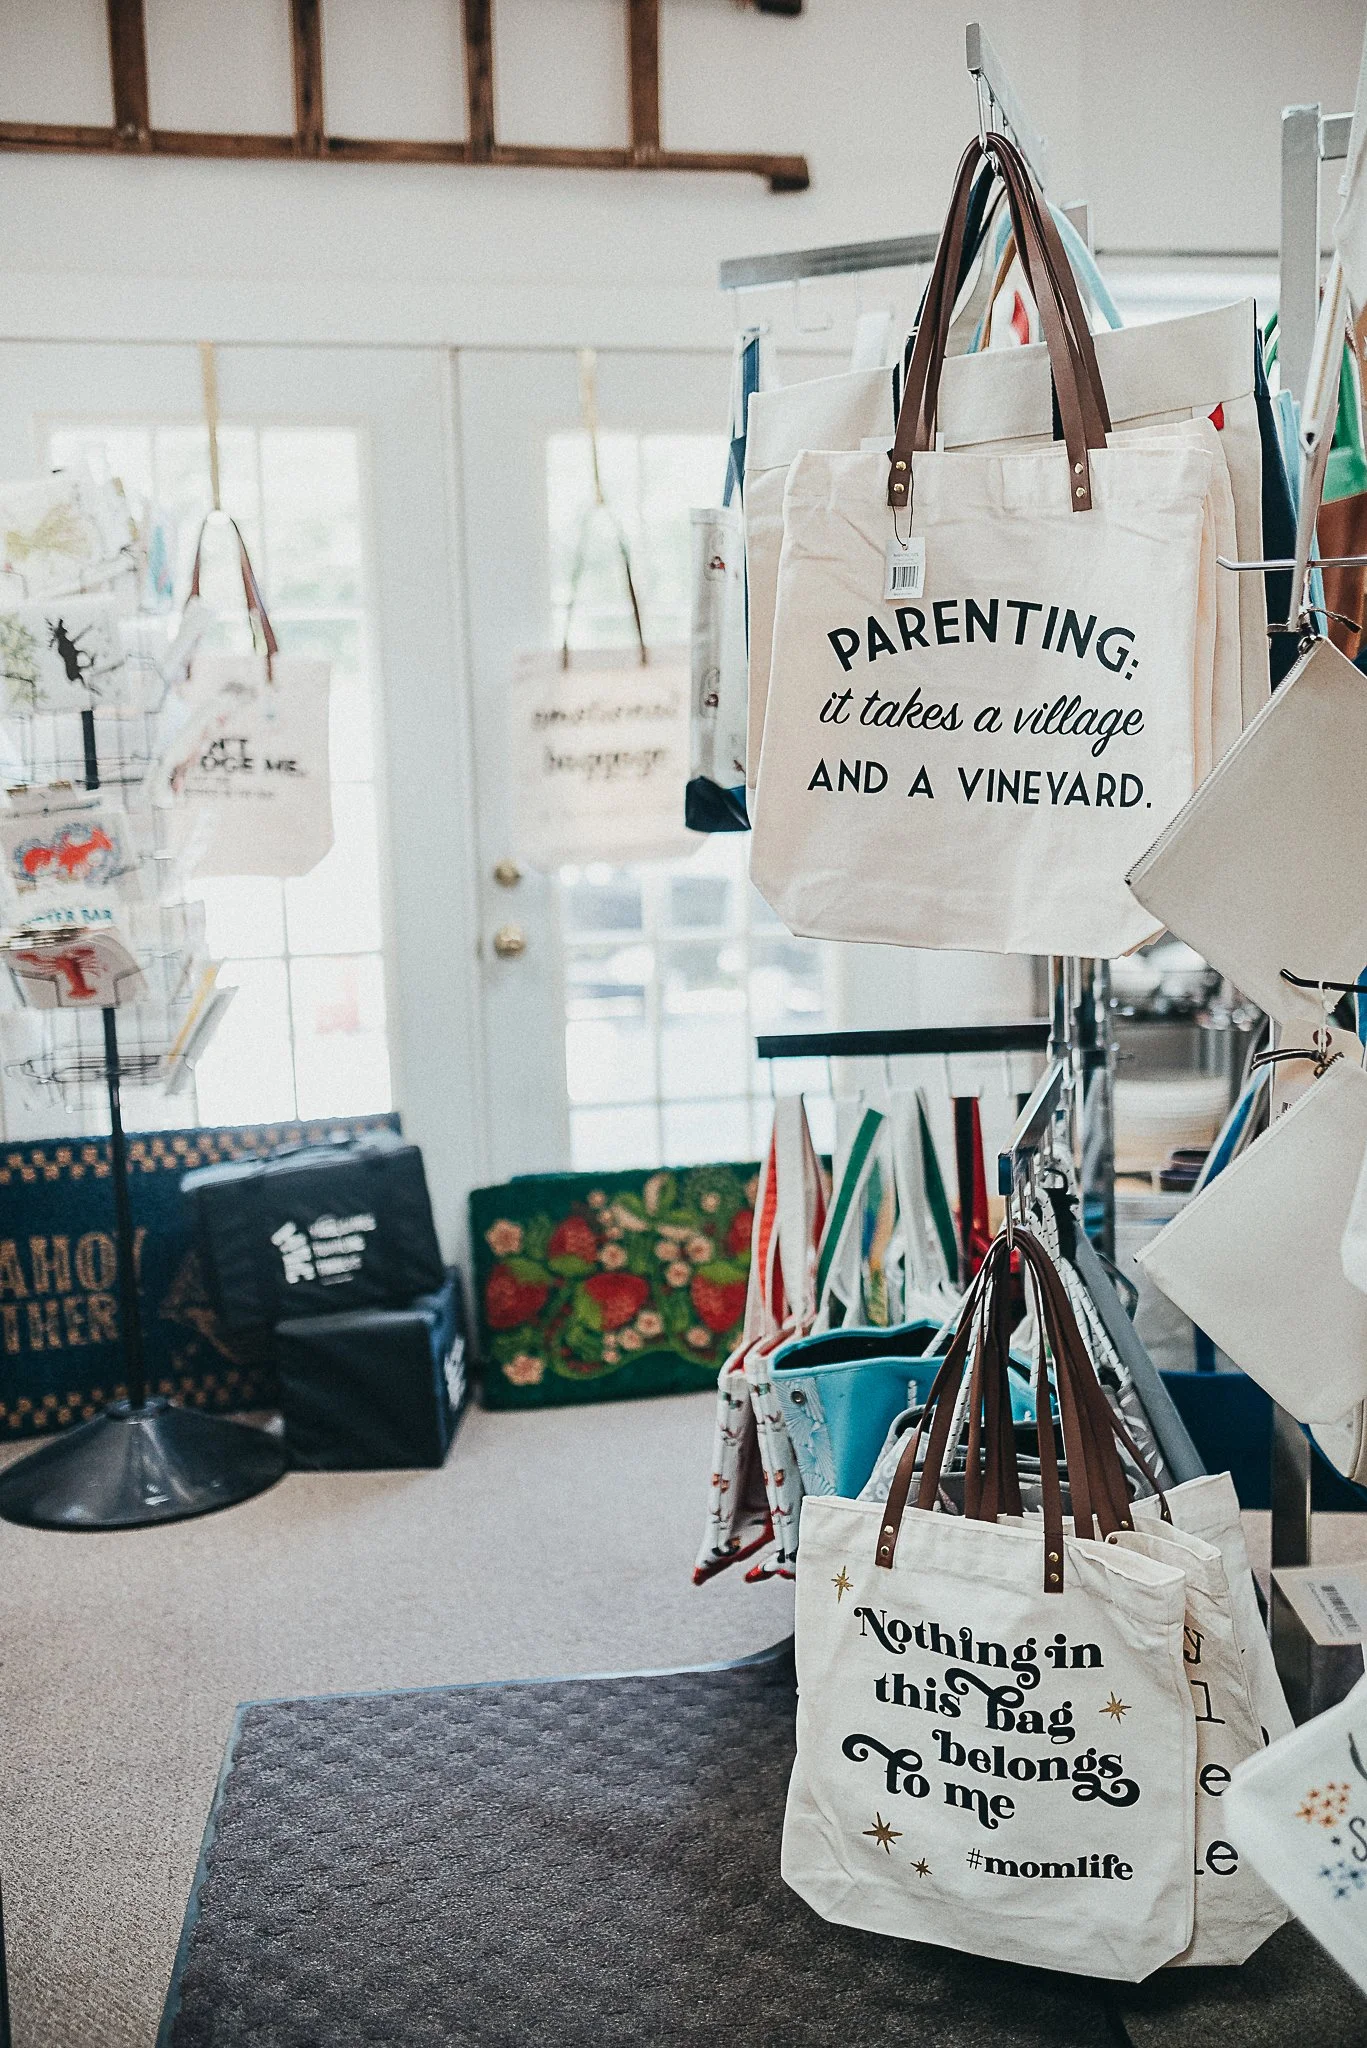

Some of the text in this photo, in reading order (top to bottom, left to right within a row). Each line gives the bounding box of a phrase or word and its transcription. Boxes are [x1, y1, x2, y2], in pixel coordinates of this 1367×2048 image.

[826, 598, 1140, 681] PARENTING:
[819, 686, 1145, 758] it takes a village
[806, 757, 1153, 809] AND A VINEYARD.
[853, 1606, 1105, 1691] Nothing in
[873, 1667, 1076, 1745] this bag
[841, 1733, 1016, 1830] to me
[931, 1728, 1141, 1808] belongs
[965, 1847, 1134, 1881] #momlife
